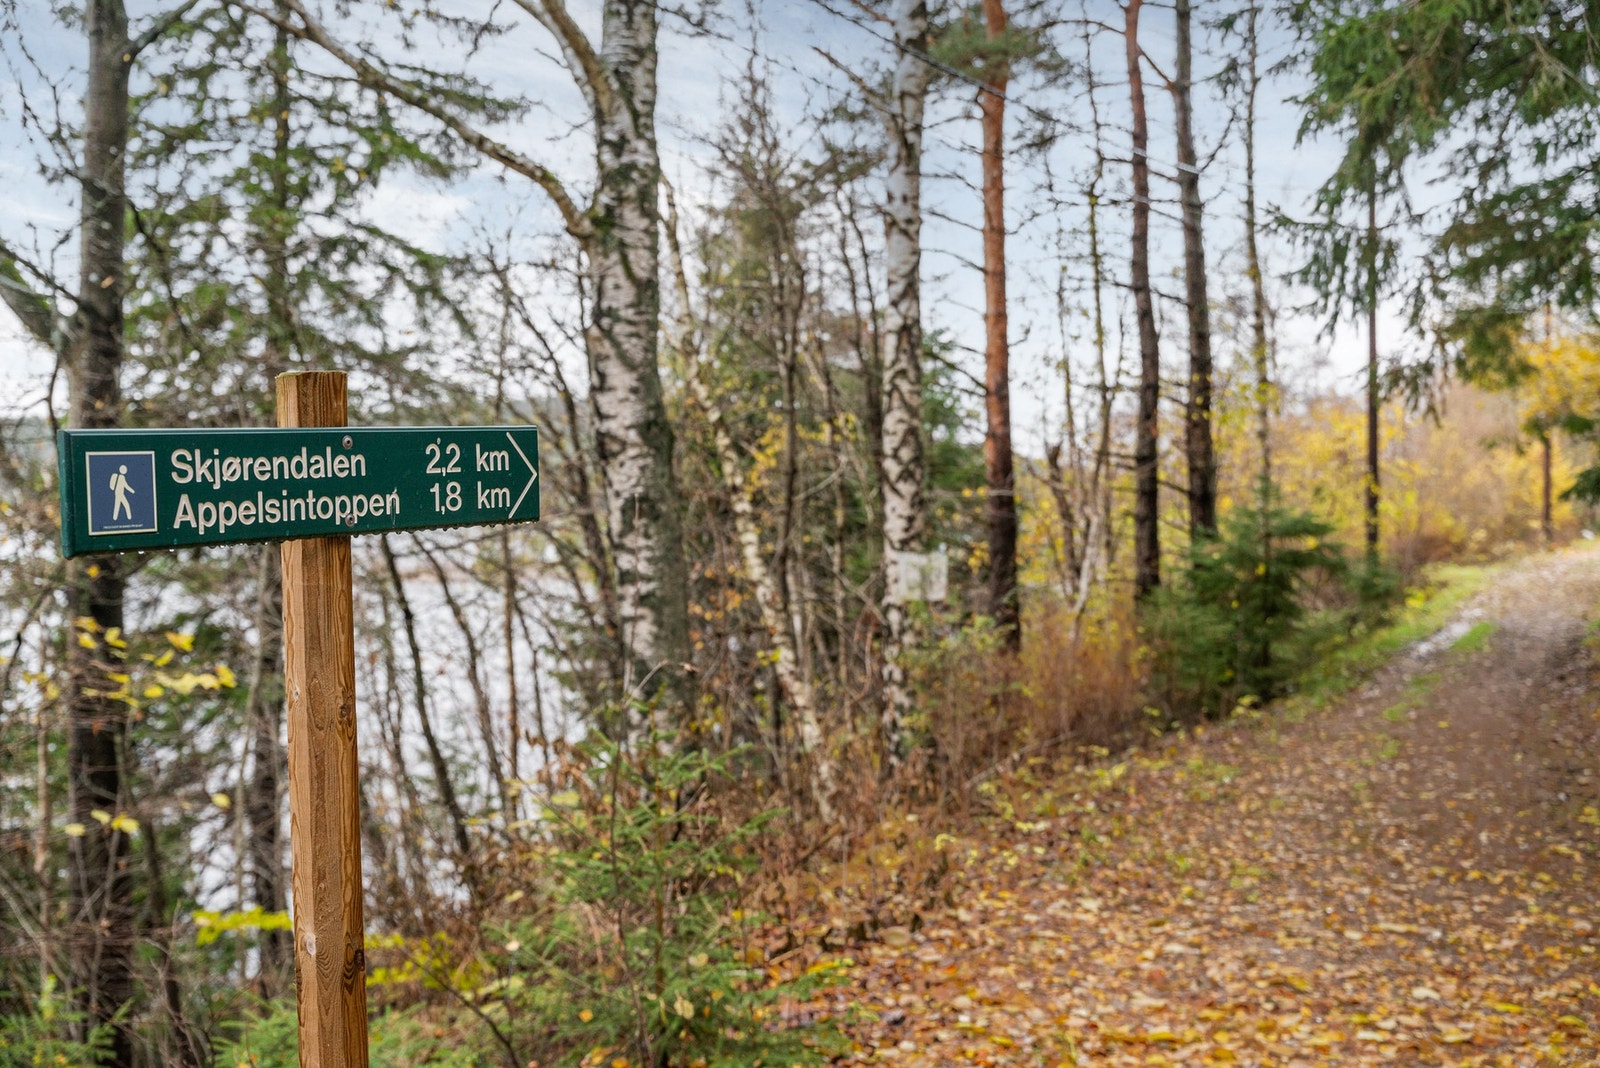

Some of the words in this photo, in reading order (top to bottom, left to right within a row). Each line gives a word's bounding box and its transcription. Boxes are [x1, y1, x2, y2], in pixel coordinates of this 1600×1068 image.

[171, 447, 366, 490] Skjørendalen
[425, 443, 462, 477] 2,2
[475, 443, 510, 472] km
[173, 489, 401, 534] Appelsintoppen
[429, 481, 463, 514] 1,8
[477, 481, 511, 509] km
